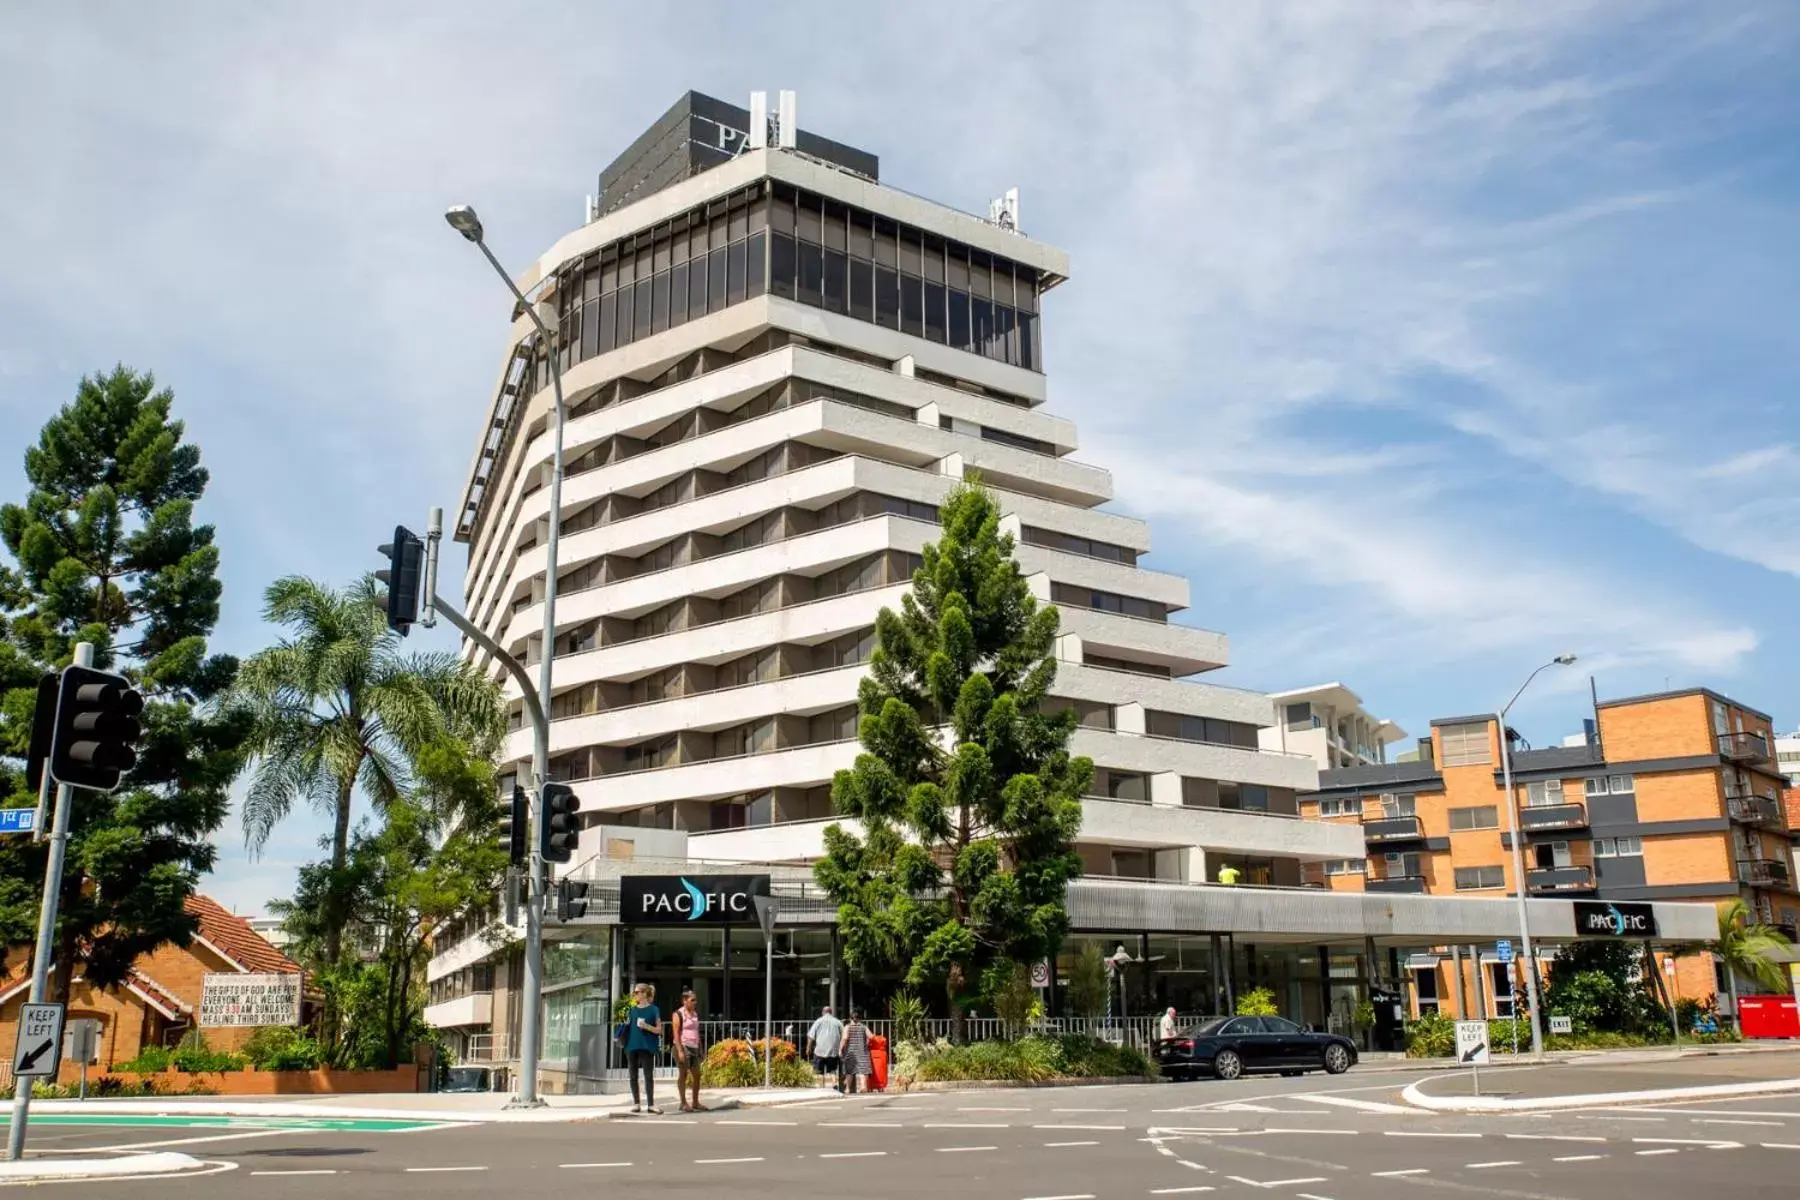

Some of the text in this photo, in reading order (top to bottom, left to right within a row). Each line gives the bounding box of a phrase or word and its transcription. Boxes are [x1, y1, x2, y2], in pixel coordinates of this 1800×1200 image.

[642, 892, 747, 913] PACIFIC
[1032, 966, 1045, 978] 50
[204, 985, 297, 995] THE GIFTS OF GOD ARE FOR
[204, 994, 295, 1005] EVERYONE ALL WELCOME
[202, 1005, 223, 1014] MASS
[241, 1004, 253, 1013] AM
[255, 1004, 290, 1013] SUNDAYS
[28, 1009, 55, 1021] KEEP
[202, 1013, 291, 1024] HEALING THIRD SUNDAY
[1461, 1025, 1483, 1033] KEEP
[1552, 1020, 1569, 1028] EXIT
[27, 1024, 53, 1036] LEFT
[1462, 1033, 1482, 1041] LEFT
